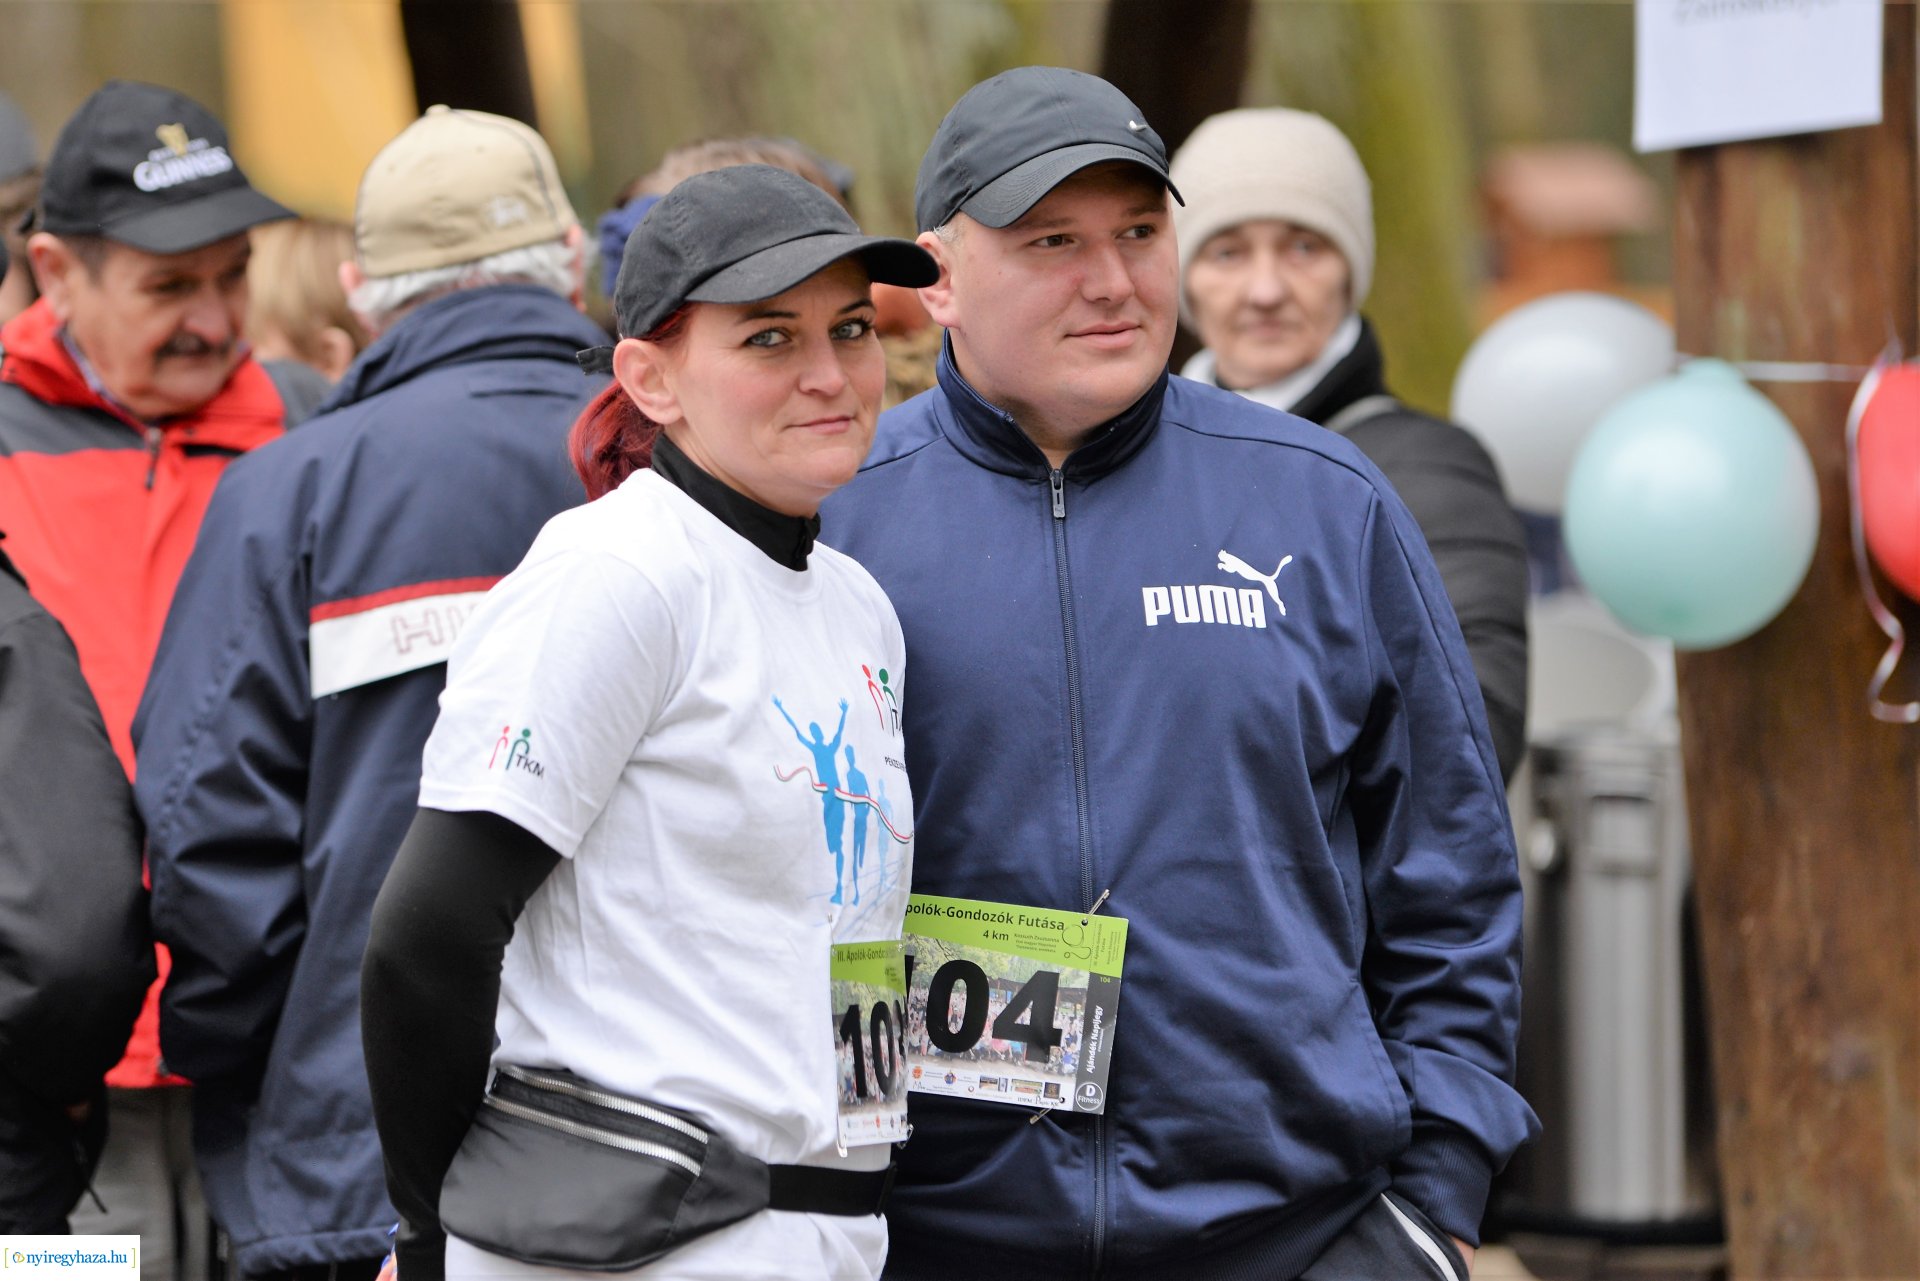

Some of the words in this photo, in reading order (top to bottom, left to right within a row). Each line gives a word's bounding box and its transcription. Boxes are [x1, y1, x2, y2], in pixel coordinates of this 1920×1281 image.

[1142, 585, 1267, 628] PUMA
[516, 753, 545, 779] TKM
[905, 902, 1014, 925] polók-Gondozók
[1018, 914, 1065, 931] Futása
[982, 930, 989, 939] 4
[992, 930, 1009, 941] km
[837, 951, 846, 963] III.
[1091, 1005, 1103, 1041] Napijegy
[839, 1000, 908, 1098] 10
[1086, 1040, 1098, 1074] Ajándék
[1077, 1095, 1101, 1104] Fitness
[1085, 1085, 1096, 1097] D
